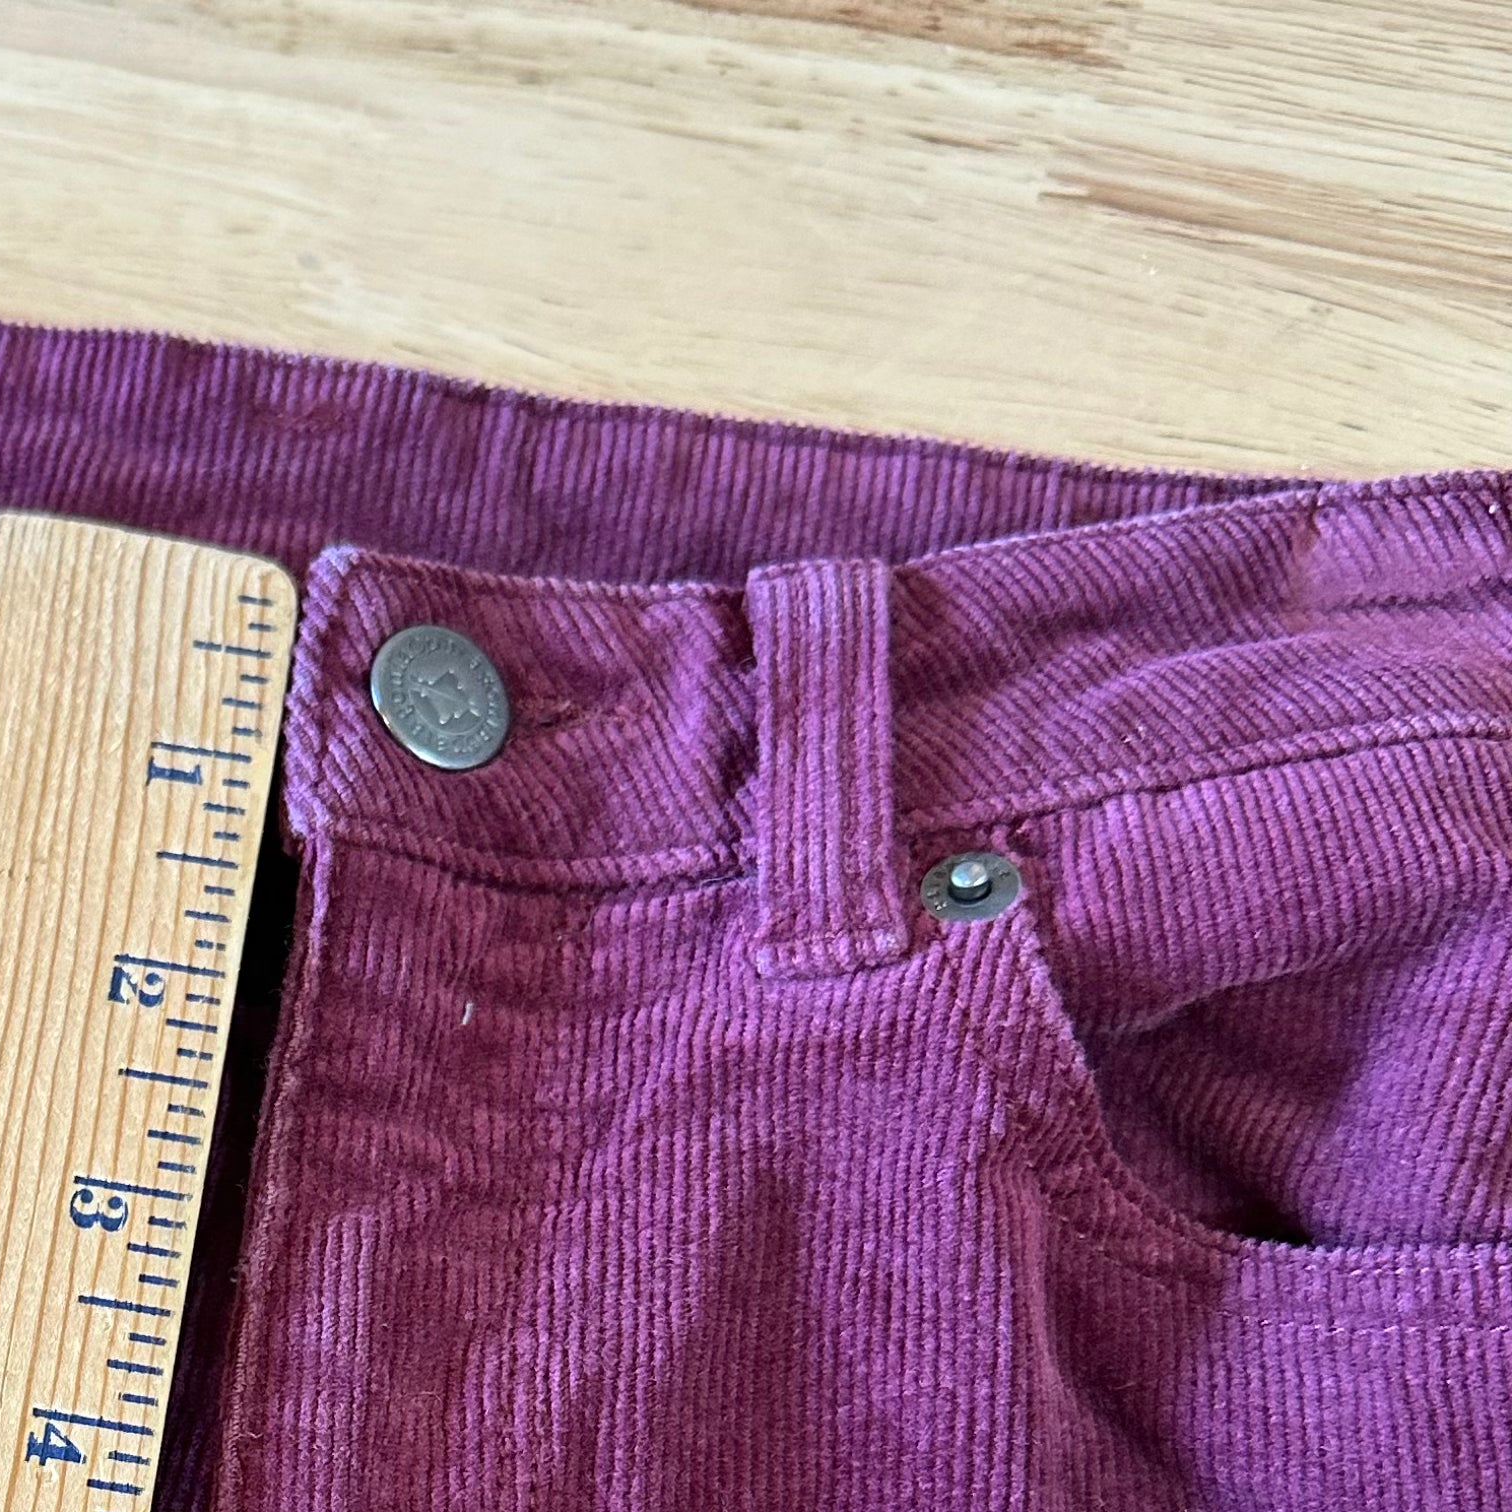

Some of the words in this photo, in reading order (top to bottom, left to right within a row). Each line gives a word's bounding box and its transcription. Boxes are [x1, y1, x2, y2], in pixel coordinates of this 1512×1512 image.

[146, 756, 204, 788] 1
[108, 963, 166, 1009] 2
[69, 1185, 129, 1234] 3
[25, 1422, 88, 1467] 4
